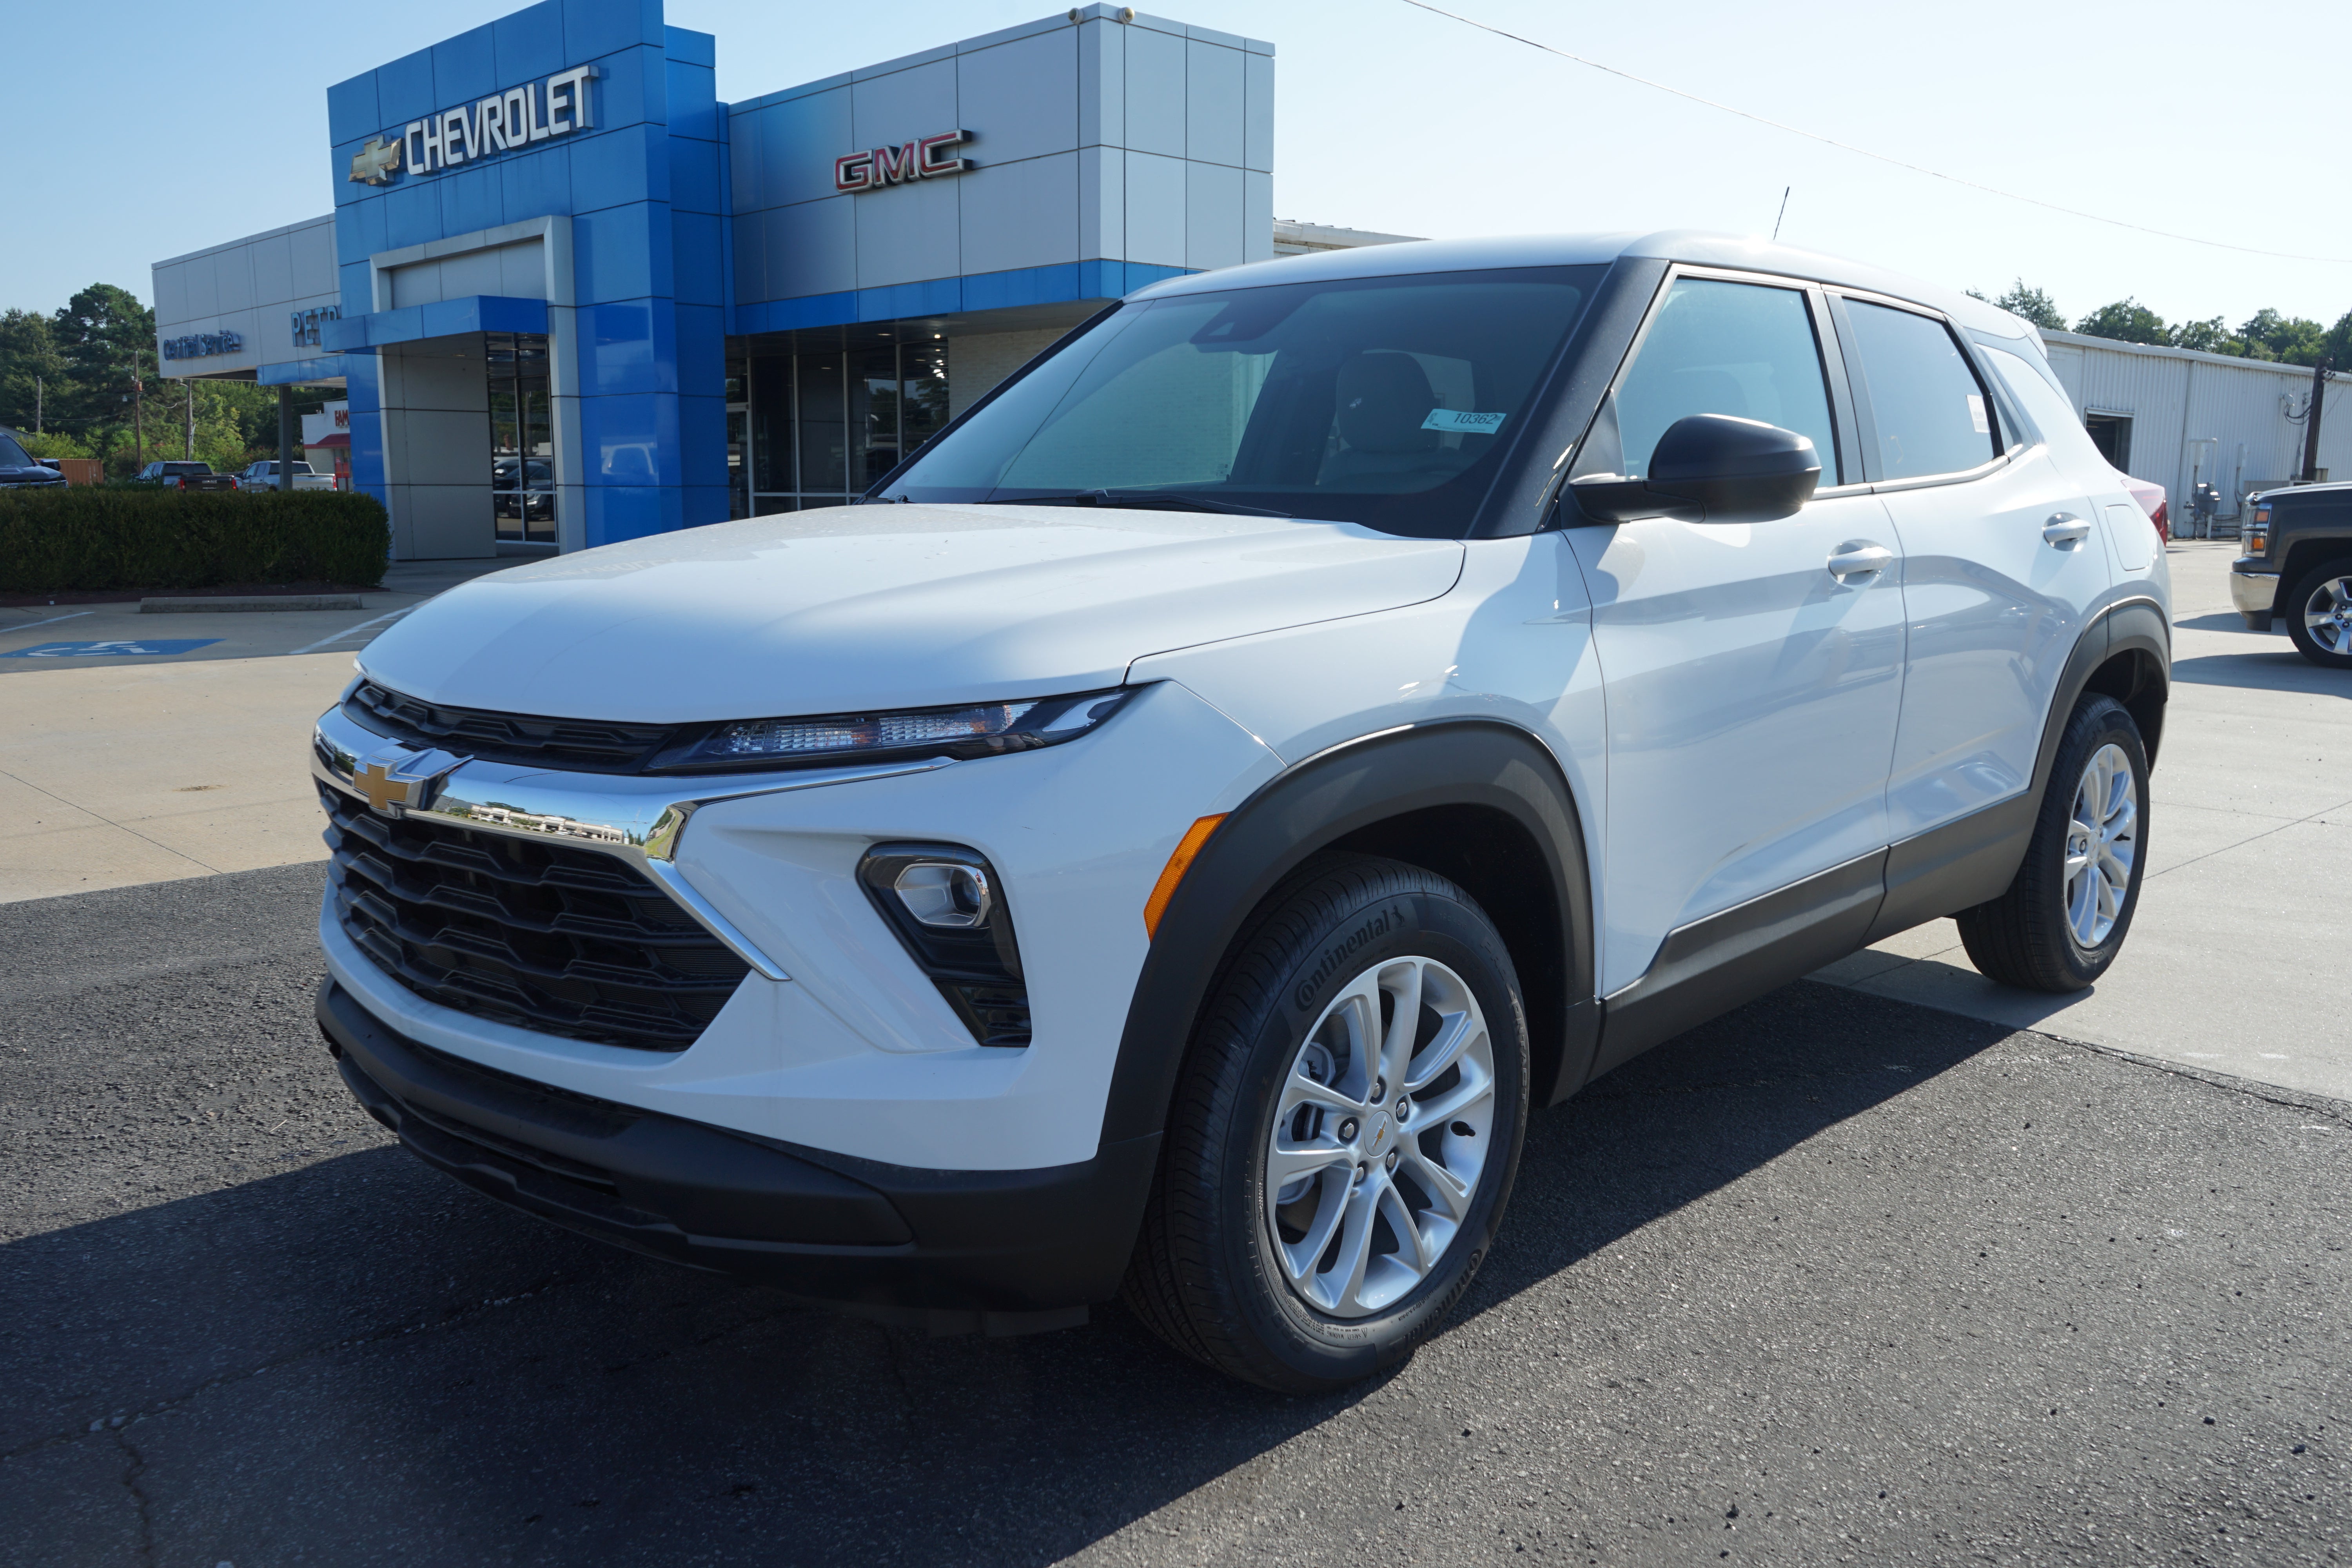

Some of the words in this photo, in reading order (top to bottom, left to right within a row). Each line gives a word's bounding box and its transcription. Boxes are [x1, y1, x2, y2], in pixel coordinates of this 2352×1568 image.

[405, 65, 590, 175] CHEVROLET
[834, 129, 967, 194] GMC
[164, 334, 199, 361] Certified
[201, 330, 236, 356] Service
[1454, 413, 1497, 424] 10362
[1294, 909, 1390, 1012] Continental
[1326, 1330, 1345, 1340] WARNING
